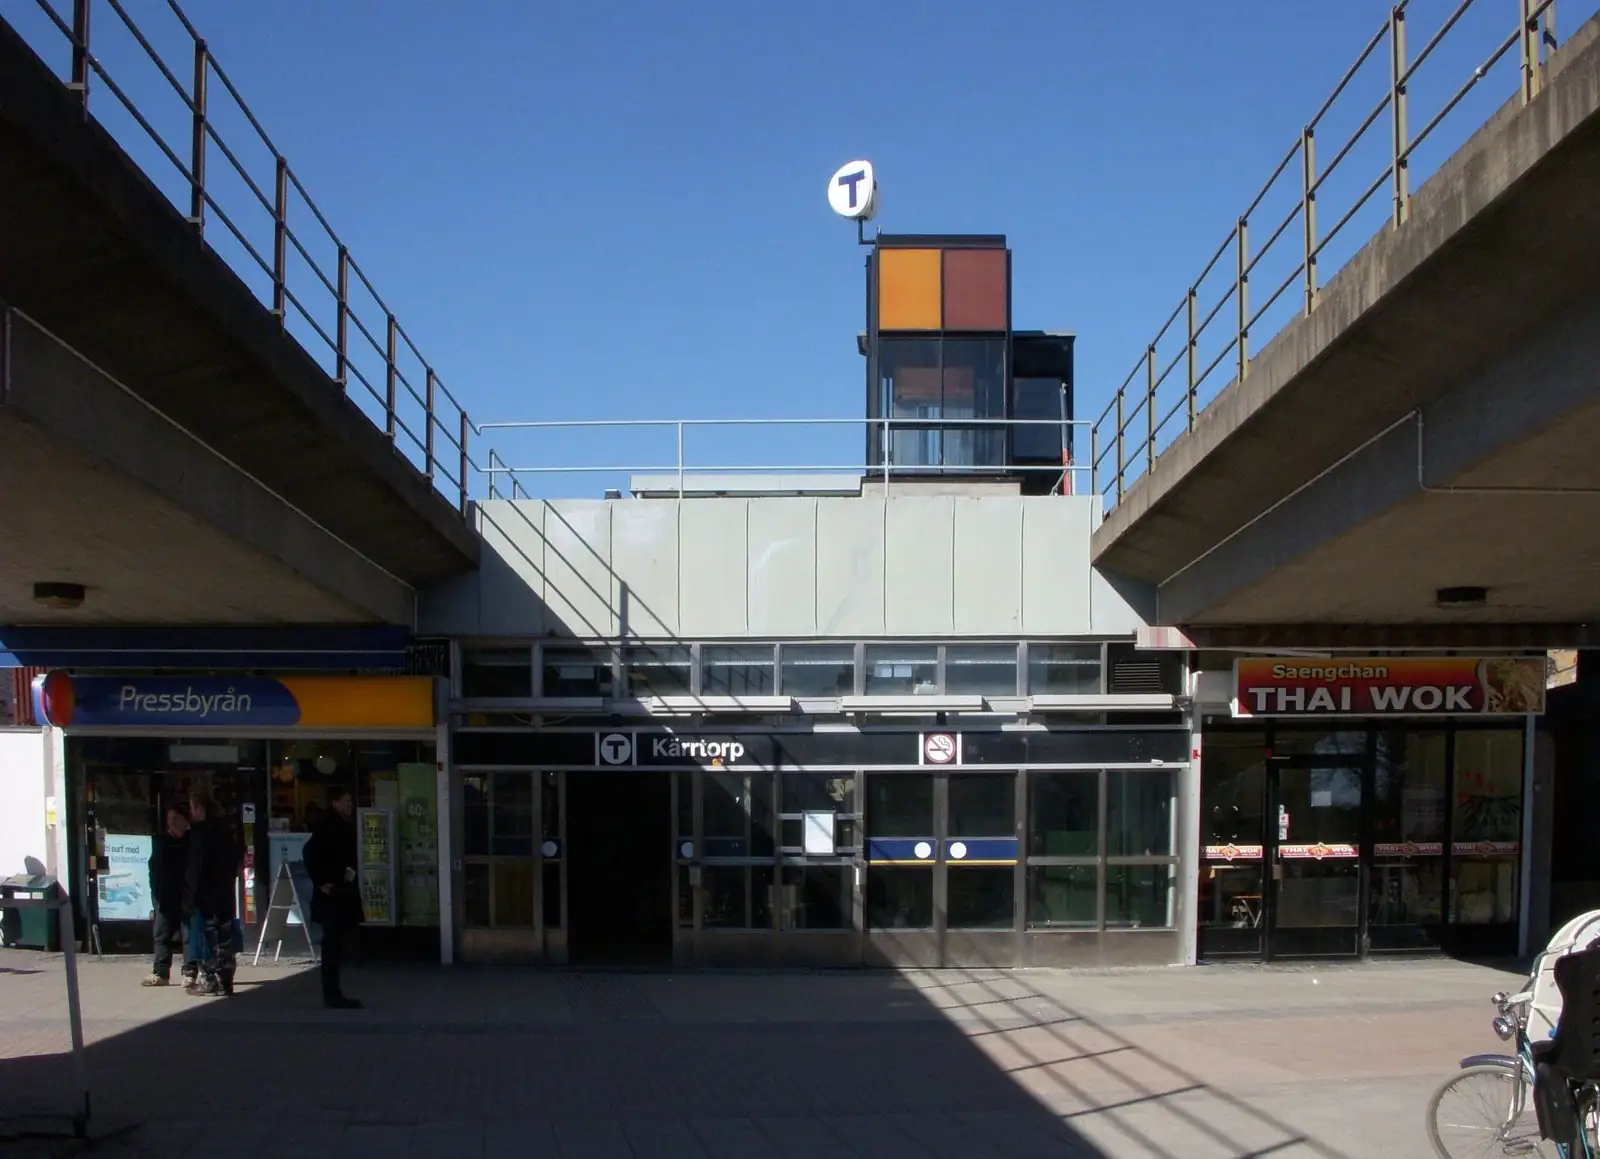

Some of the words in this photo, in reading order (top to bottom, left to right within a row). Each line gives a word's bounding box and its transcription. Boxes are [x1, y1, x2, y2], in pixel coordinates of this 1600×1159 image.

[838, 169, 865, 208] T
[1272, 664, 1388, 682] Saengchan
[119, 685, 252, 717] Pressbyrån
[1248, 686, 1351, 711] THAI
[1370, 685, 1473, 711] WOK
[652, 737, 745, 762] Kärrtorp
[1331, 846, 1354, 854] WOK
